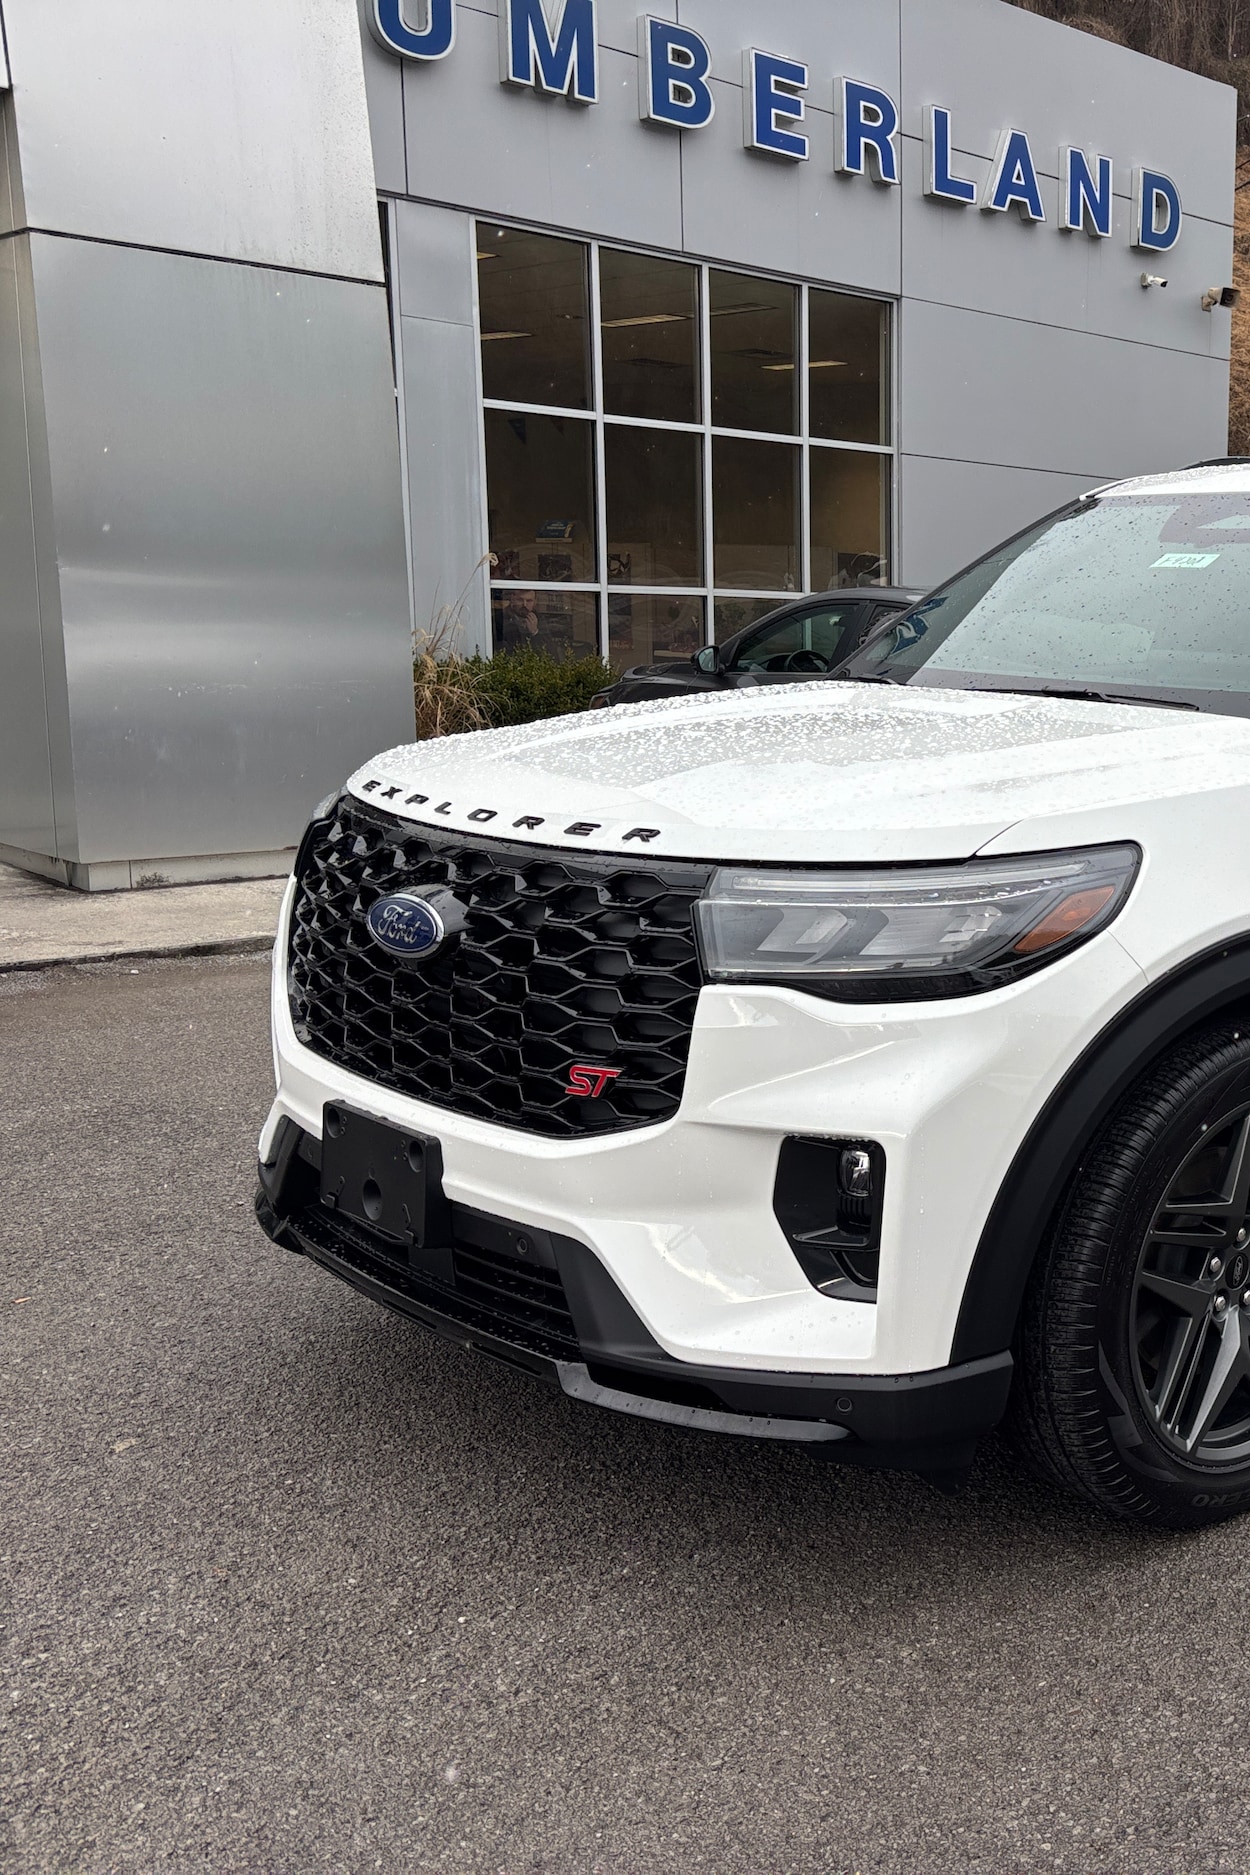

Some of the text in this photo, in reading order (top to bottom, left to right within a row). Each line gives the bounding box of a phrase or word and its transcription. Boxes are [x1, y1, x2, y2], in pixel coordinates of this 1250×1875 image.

[362, 780, 661, 842] EXPLORER
[378, 904, 429, 944] Ford
[565, 1065, 622, 1097] ST
